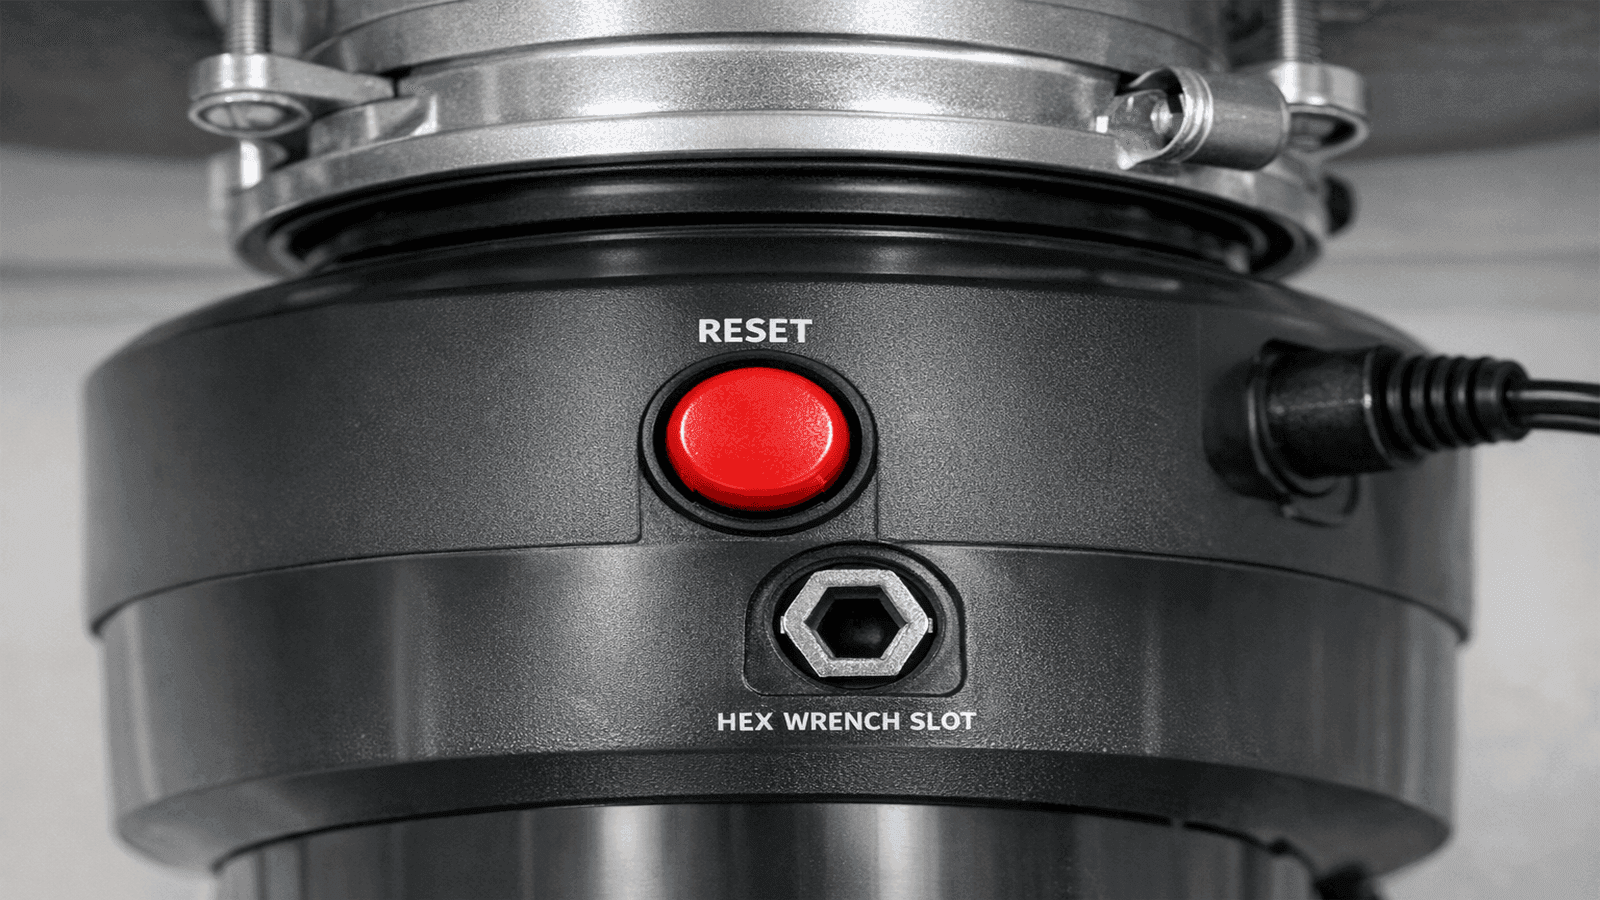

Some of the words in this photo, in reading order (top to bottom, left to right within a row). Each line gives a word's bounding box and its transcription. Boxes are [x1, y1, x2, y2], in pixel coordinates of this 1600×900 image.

[698, 317, 813, 343] RESET
[717, 711, 774, 732] HEX
[783, 711, 900, 731] WRENCH
[909, 711, 977, 731] SLOT
